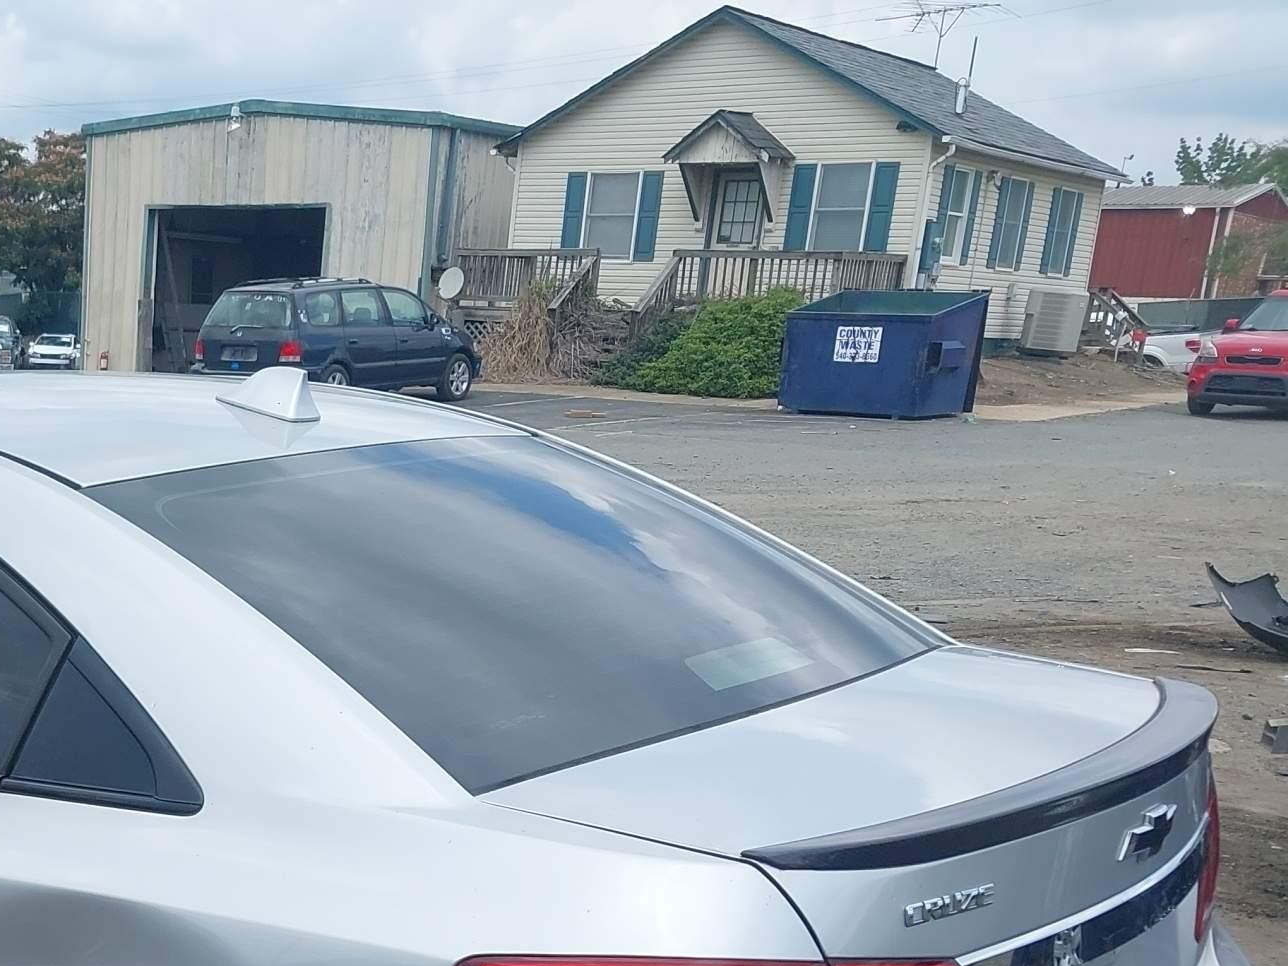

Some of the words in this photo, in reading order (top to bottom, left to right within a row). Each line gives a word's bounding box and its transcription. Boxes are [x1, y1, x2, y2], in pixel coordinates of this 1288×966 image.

[839, 328, 880, 339] COUNTY
[839, 340, 874, 350] WASTE
[904, 882, 995, 927] CRUZE
